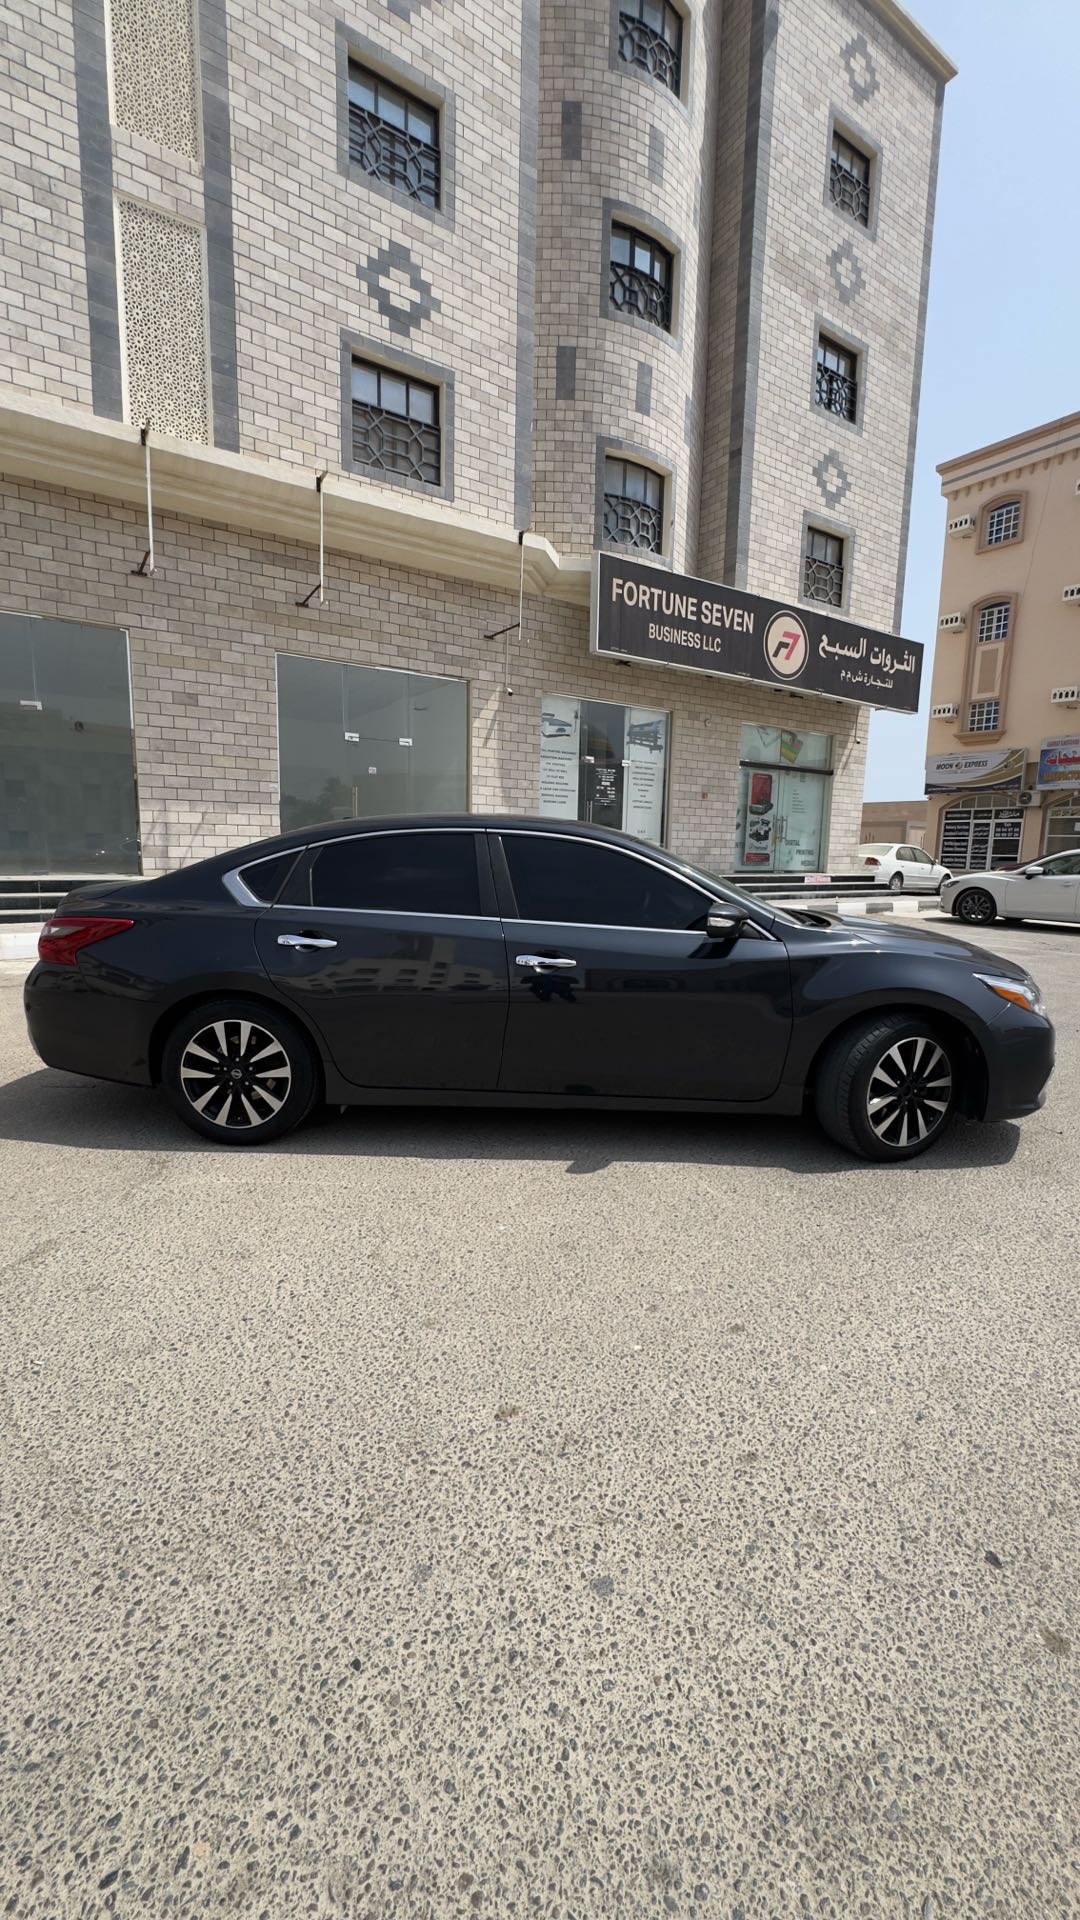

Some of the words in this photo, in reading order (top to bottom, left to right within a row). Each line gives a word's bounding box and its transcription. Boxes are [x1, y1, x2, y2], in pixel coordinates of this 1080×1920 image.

[611, 577, 698, 621] FORTUNE
[701, 600, 754, 634] SEVEN
[648, 623, 701, 649] BUSINESS
[702, 635, 722, 653] LLC
[818, 633, 867, 661] السبع
[870, 647, 917, 674] الثروات
[863, 672, 894, 690] للتجارة
[935, 763, 954, 771] MOON
[963, 760, 988, 769] EXPRESS
